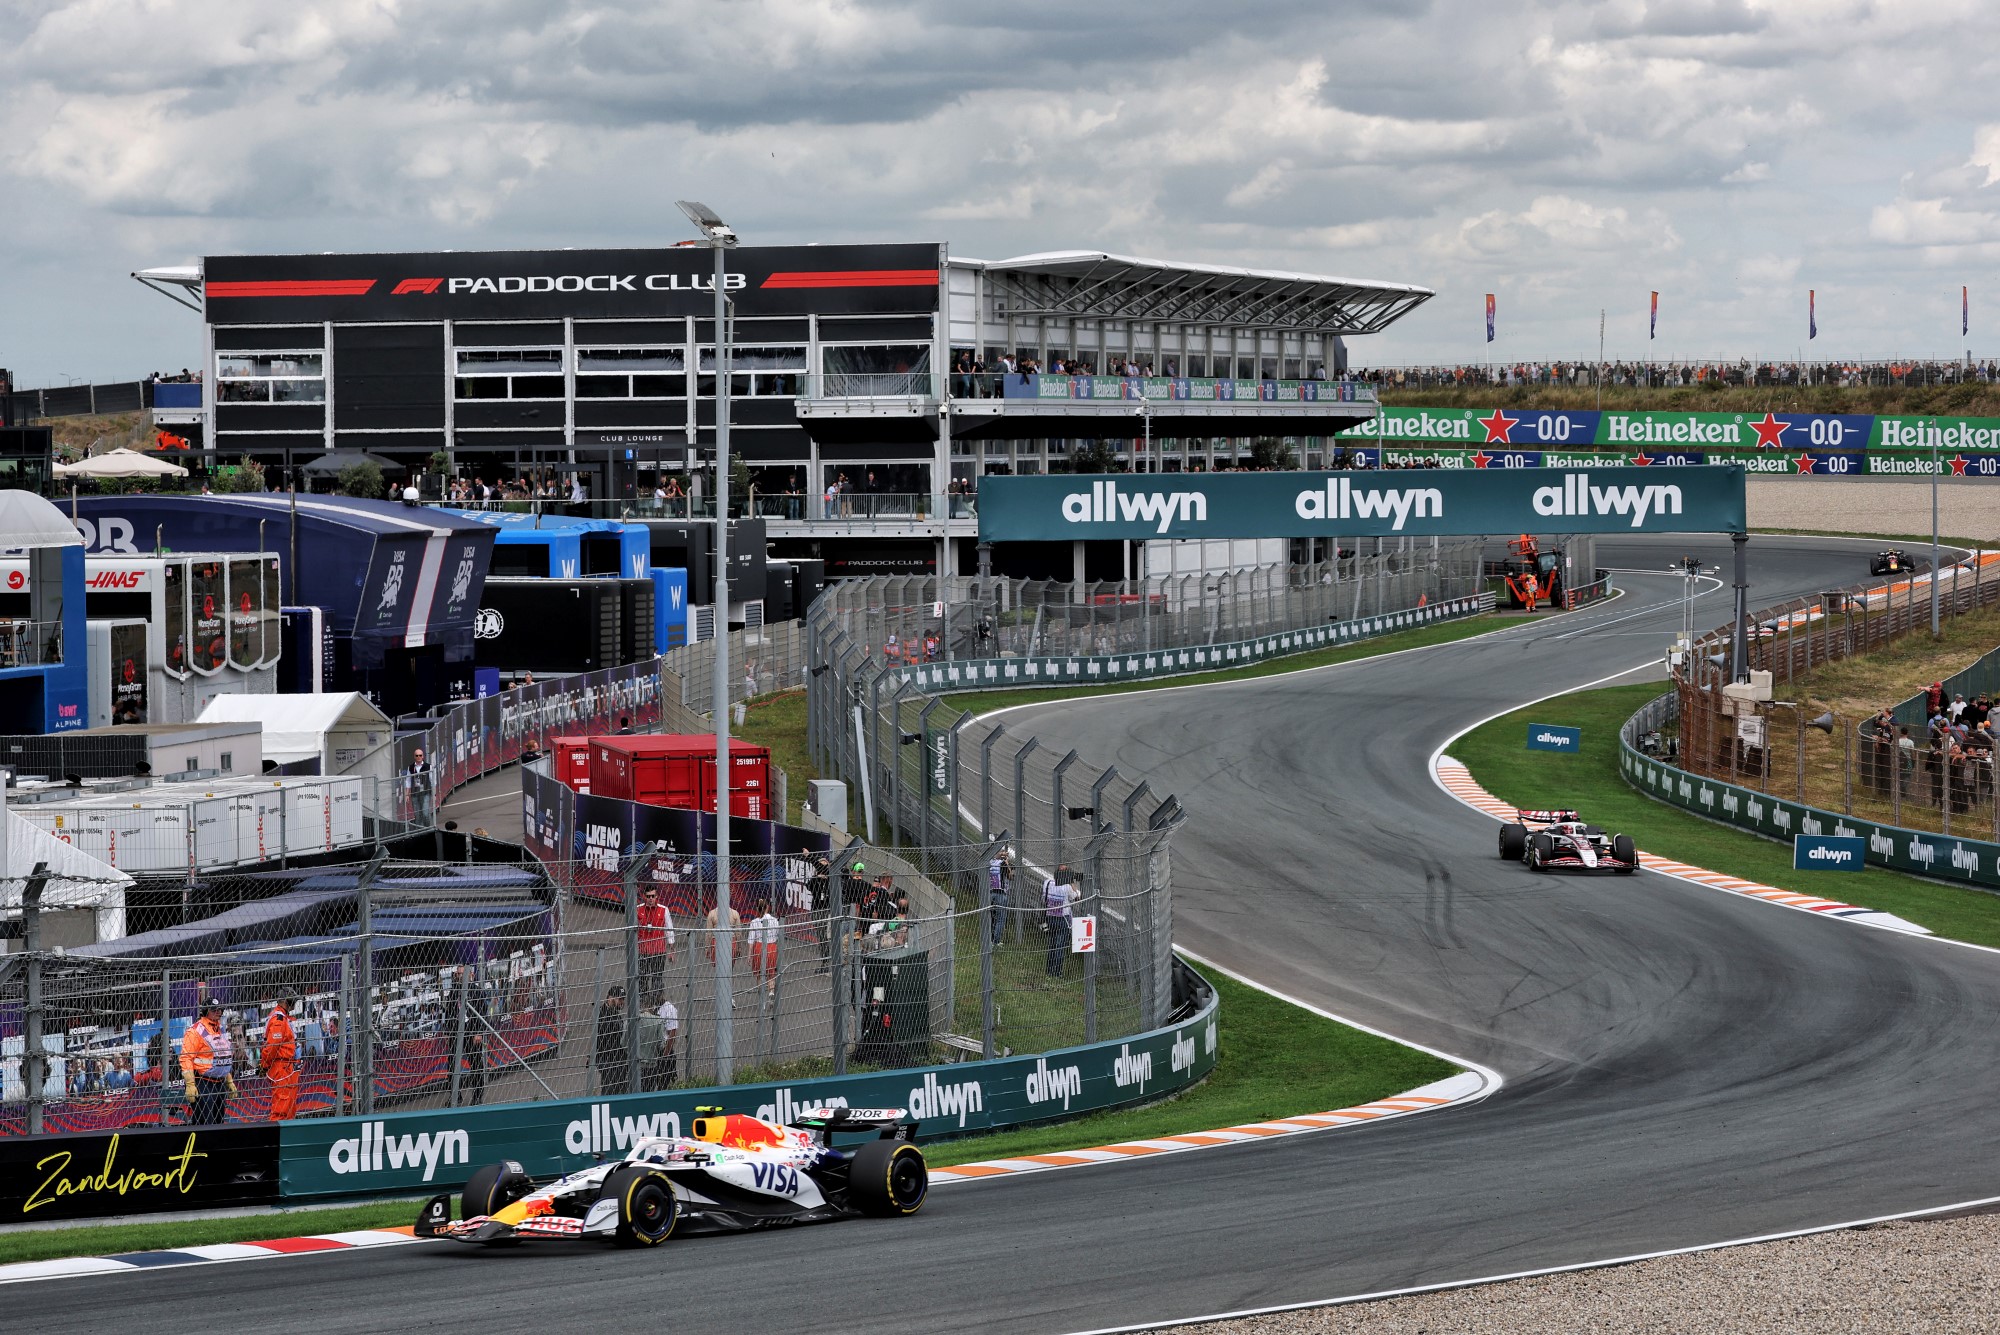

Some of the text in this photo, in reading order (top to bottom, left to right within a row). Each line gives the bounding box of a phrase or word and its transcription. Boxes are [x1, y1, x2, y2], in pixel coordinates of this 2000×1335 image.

[448, 275, 637, 294] PADDOCK
[1537, 415, 1570, 441] 0.0
[1608, 416, 1843, 445] Heineken 0.0
[1828, 456, 1849, 473] 0.0
[1062, 481, 1207, 534] allwyn
[1295, 477, 1443, 530] allwyn
[1532, 474, 1683, 527] allwyn
[561, 558, 575, 578] W
[632, 553, 645, 578] W
[85, 571, 145, 588] HAAS
[671, 585, 681, 610] W
[55, 719, 82, 728] ALPINE
[1537, 733, 1570, 746] allwyn
[935, 736, 948, 789] allwyn
[586, 824, 621, 848] LIKE NO
[586, 846, 620, 872] OTHER
[1808, 846, 1852, 864] allwyn
[1952, 842, 1979, 878] allwyn
[1114, 1044, 1152, 1094] allwyn
[1026, 1058, 1081, 1110] allwyn
[909, 1073, 982, 1127] allwyn
[329, 1121, 469, 1181] allwyn
[23, 1132, 208, 1213] Zandvoort
[749, 1162, 799, 1197] VISA
